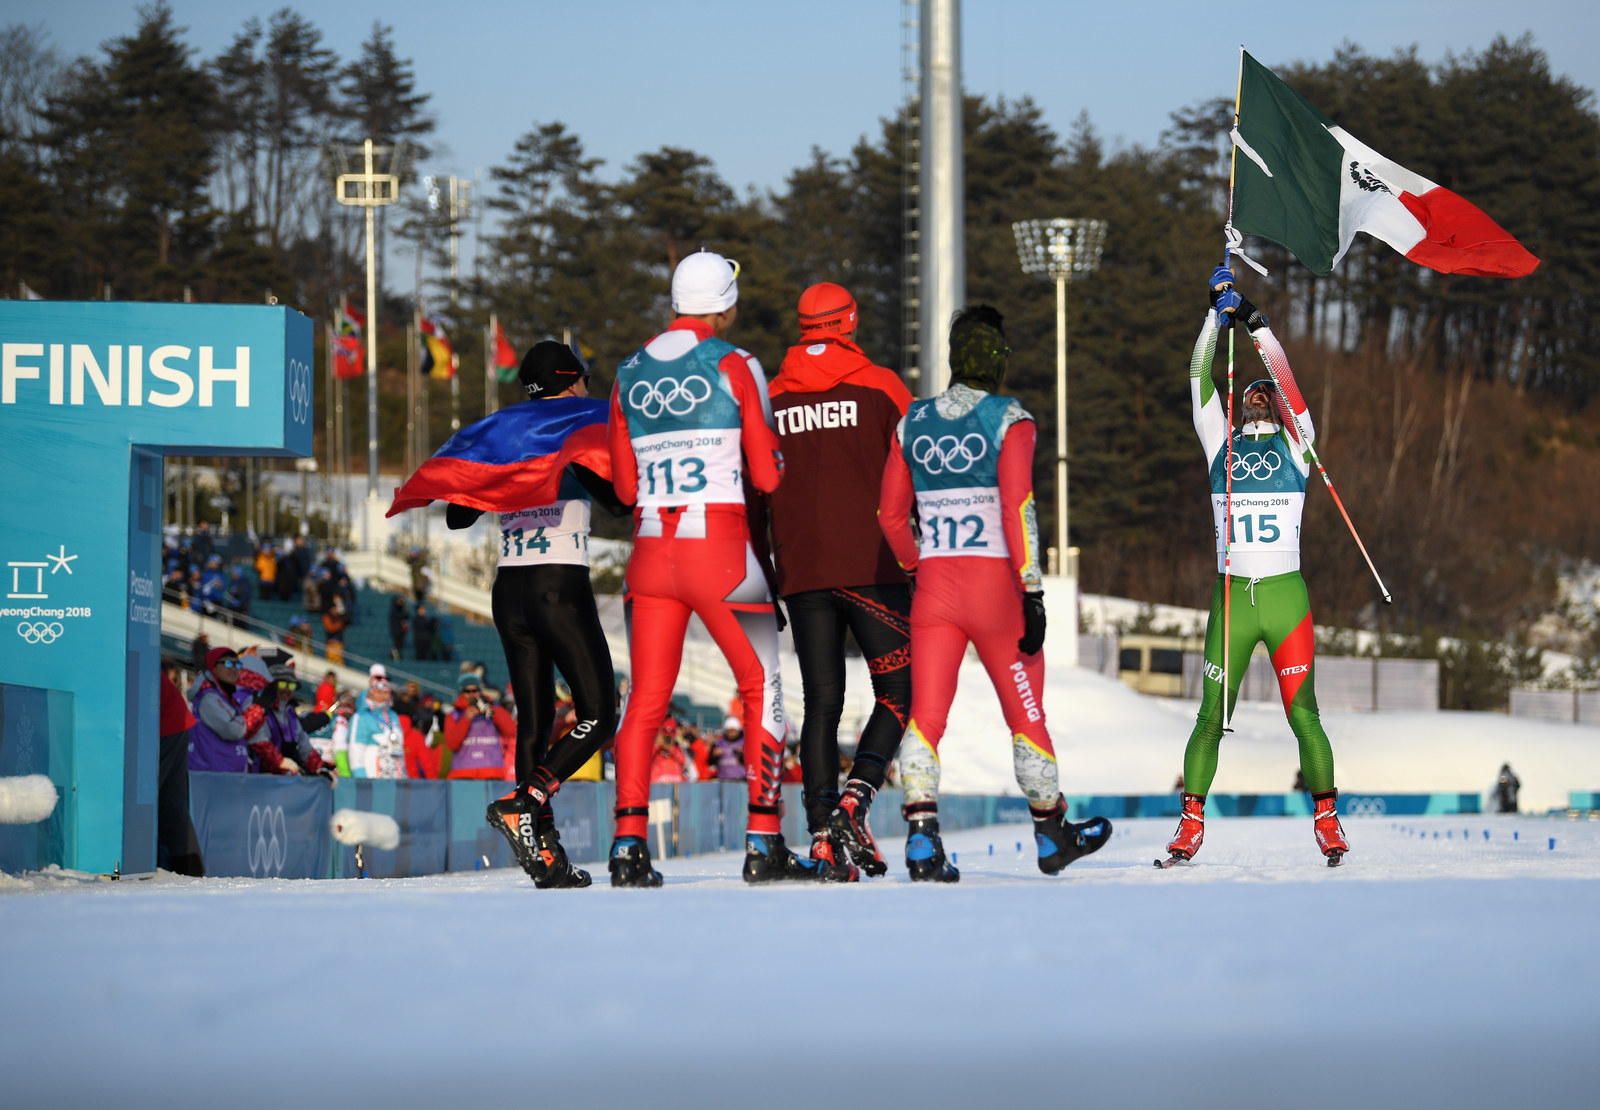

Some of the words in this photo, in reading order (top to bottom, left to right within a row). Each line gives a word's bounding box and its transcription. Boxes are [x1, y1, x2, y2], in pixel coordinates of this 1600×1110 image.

[2, 343, 250, 408] FINISH
[774, 400, 858, 436] TONGA
[695, 436, 722, 446] 2018
[646, 457, 708, 495] 113
[972, 494, 995, 504] 2018
[1216, 499, 1269, 508] PyengChang
[1270, 498, 1289, 506] 2018
[539, 507, 560, 517] 2018
[927, 514, 988, 549] 112
[1224, 514, 1281, 543] 115
[502, 526, 551, 557] 114
[0, 606, 65, 619] yeongChang
[65, 606, 92, 618] 2018
[570, 719, 598, 739] COL
